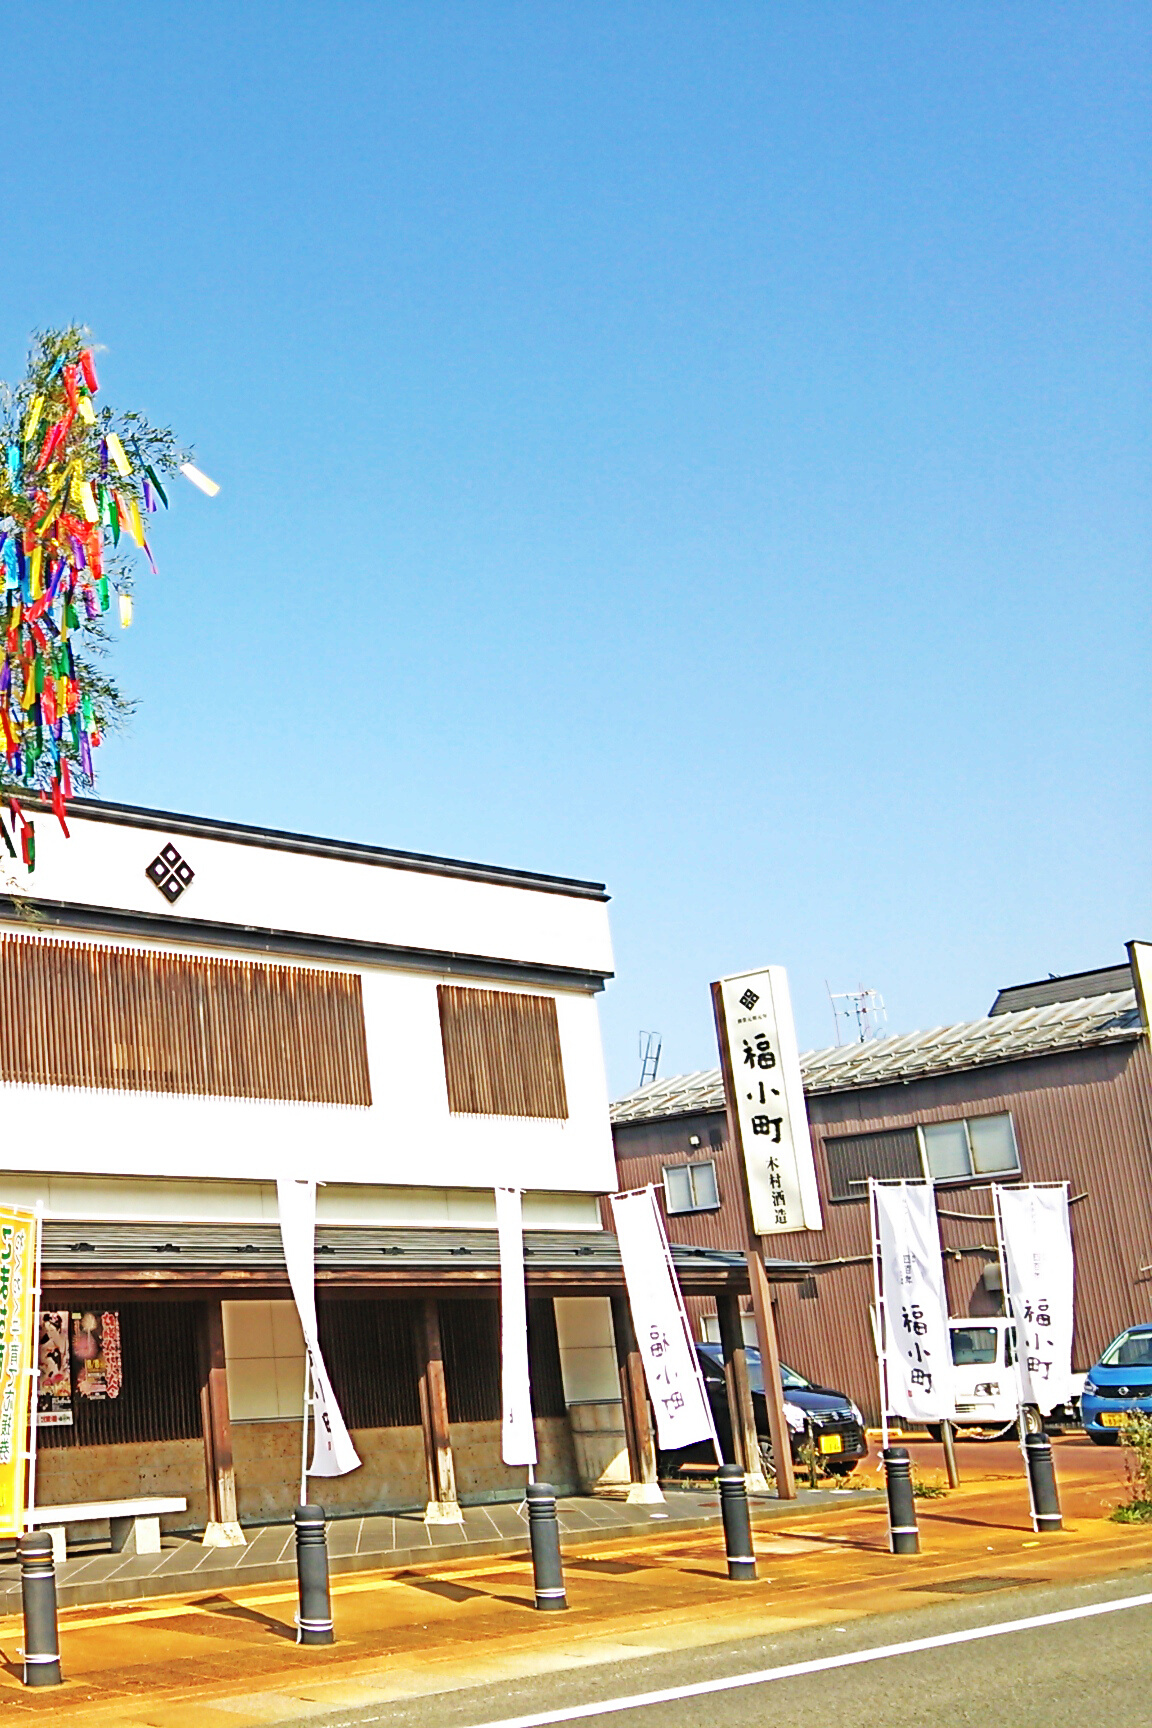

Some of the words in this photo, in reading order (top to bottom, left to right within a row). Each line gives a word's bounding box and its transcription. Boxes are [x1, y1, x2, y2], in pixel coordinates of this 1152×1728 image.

[743, 1033, 783, 1143] 福小町
[766, 1157, 787, 1224] 木村酒造
[902, 1305, 932, 1394] 福小町
[1024, 1299, 1054, 1380] 福小町
